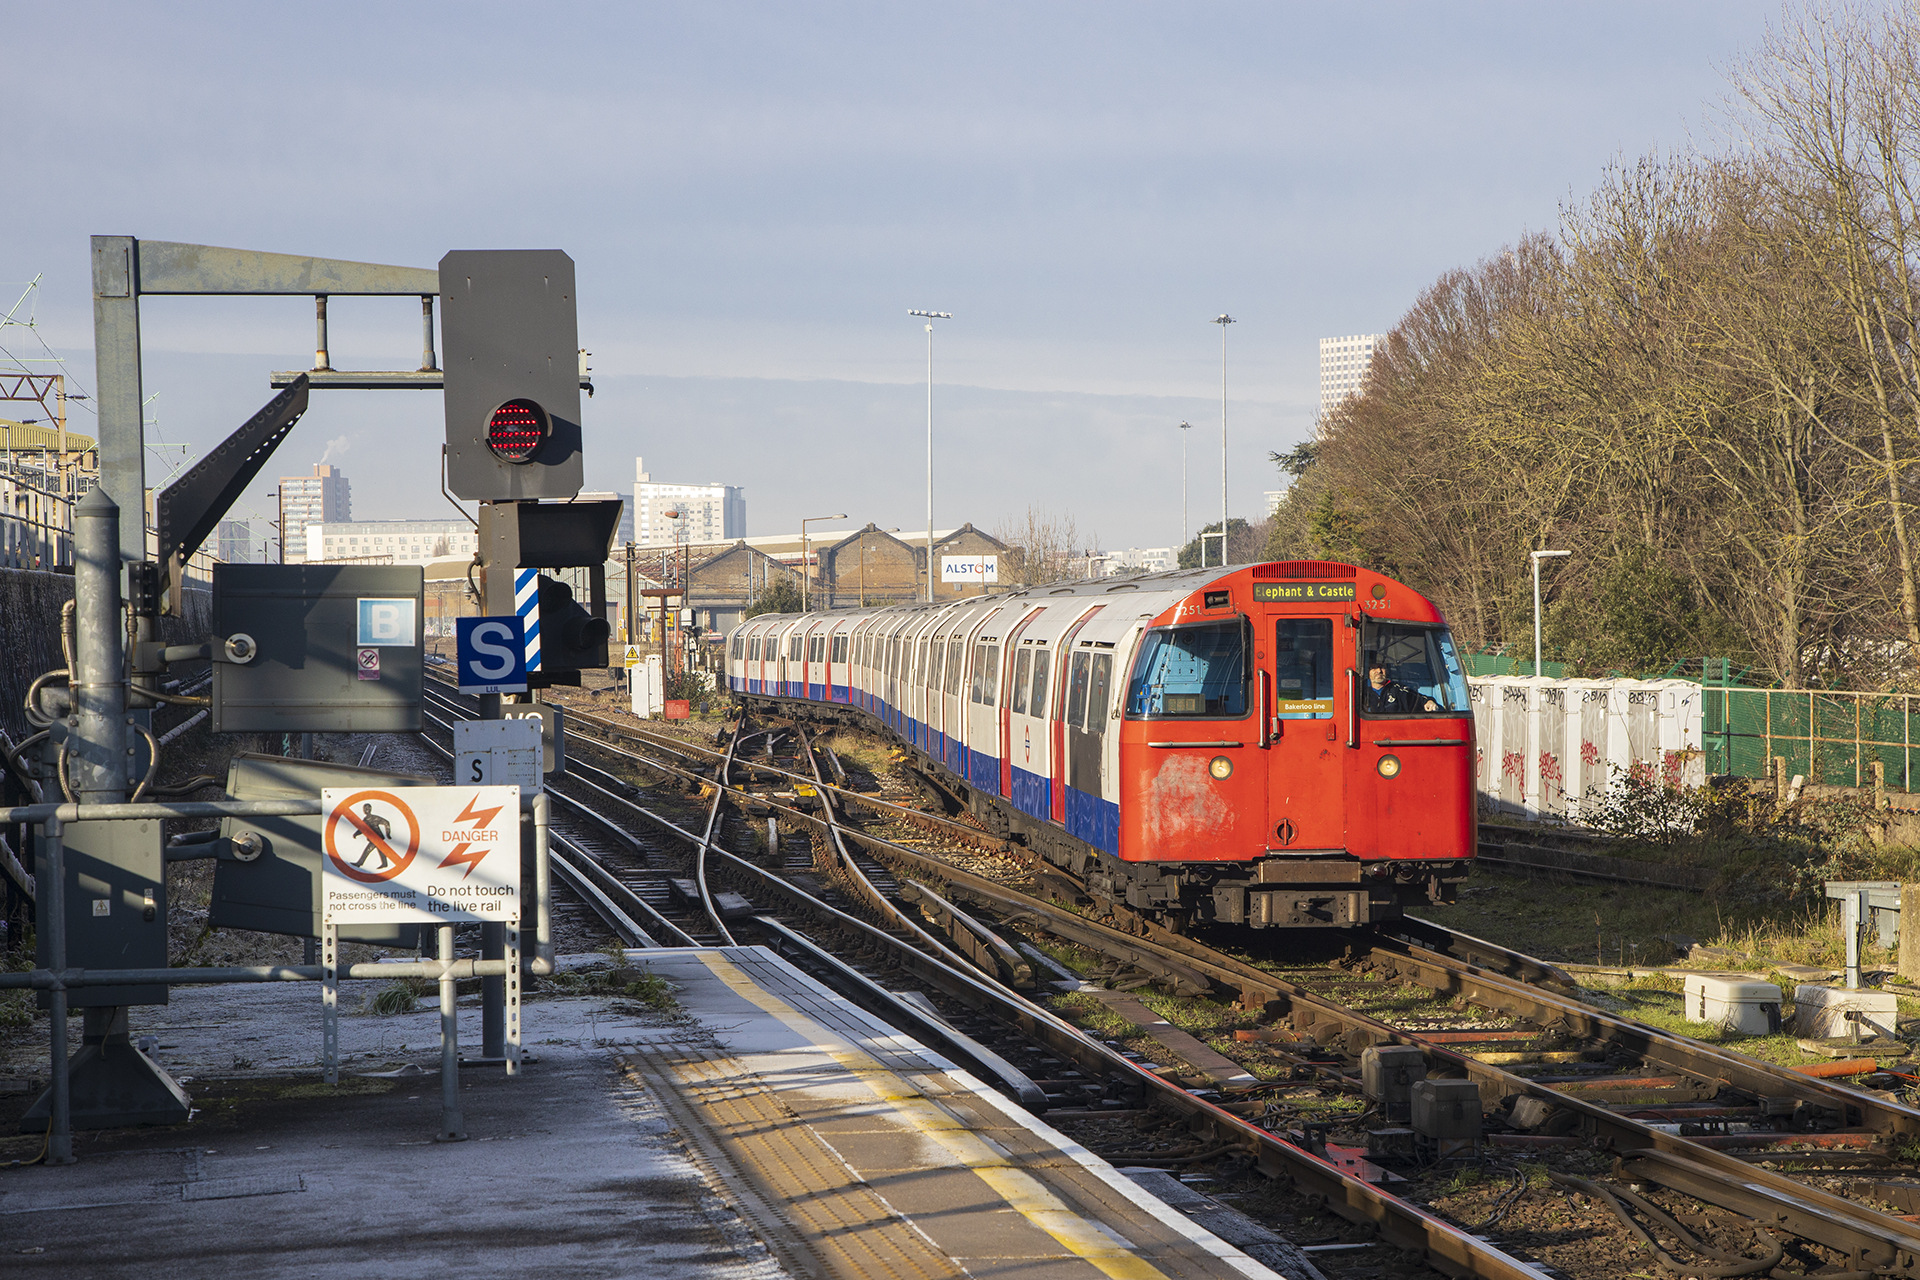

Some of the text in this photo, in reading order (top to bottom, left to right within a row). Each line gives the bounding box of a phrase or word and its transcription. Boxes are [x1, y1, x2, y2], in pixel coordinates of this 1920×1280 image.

[946, 563, 994, 574] ALSTOM
[1255, 586, 1353, 599] Elephant & Castle
[1364, 599, 1391, 610] 3251
[372, 605, 400, 638] B
[469, 622, 516, 680] S
[471, 759, 483, 783] S
[442, 831, 498, 842] DANGER
[329, 890, 416, 901] Passengers must
[427, 884, 514, 897] Do not touch
[329, 901, 416, 910] not cross the line
[427, 900, 501, 912] the live rail
